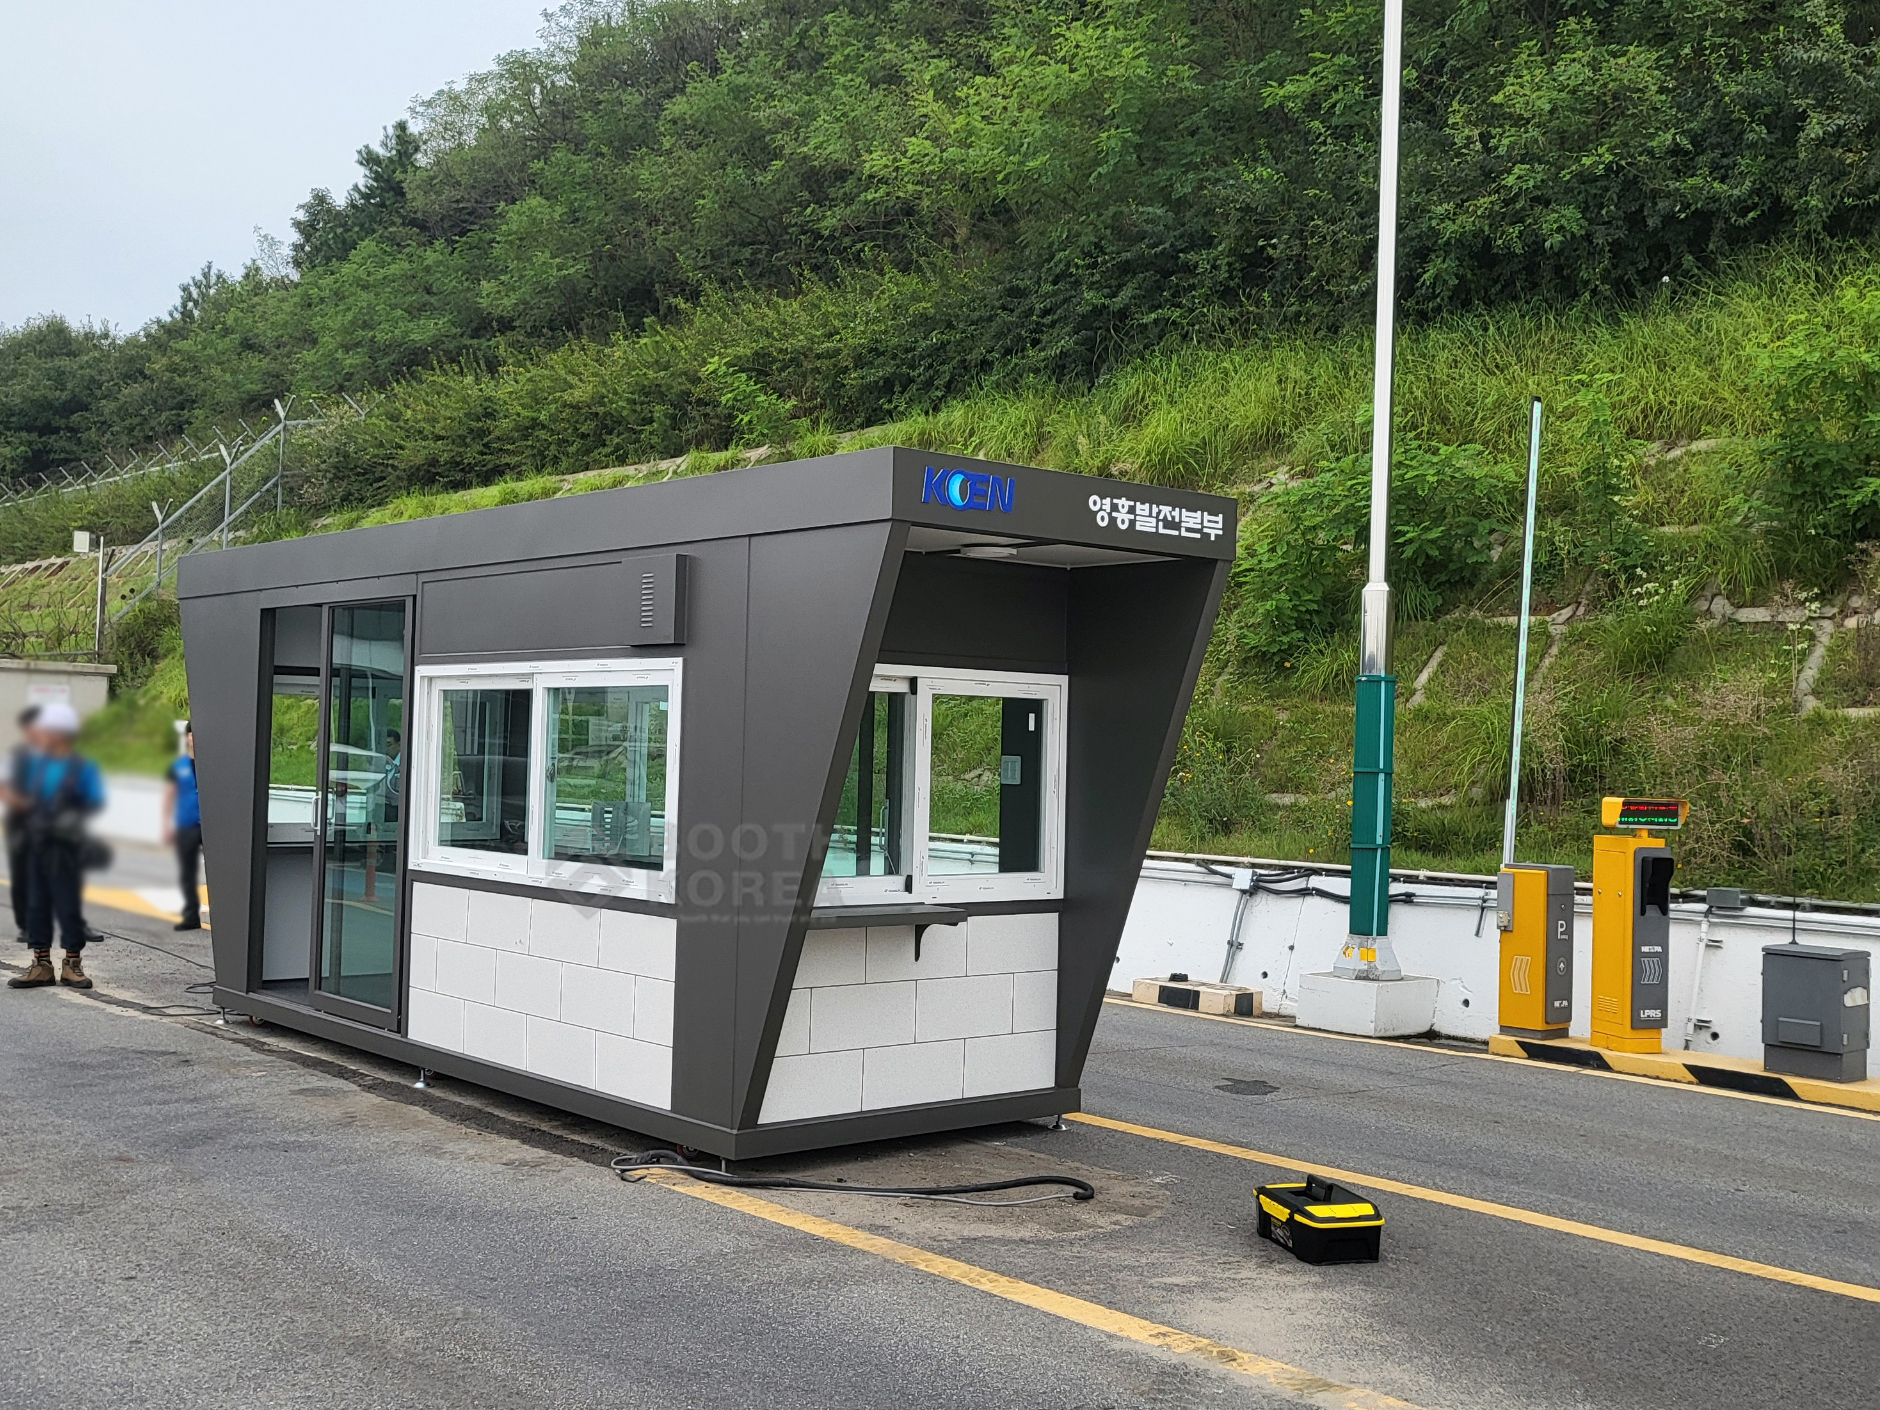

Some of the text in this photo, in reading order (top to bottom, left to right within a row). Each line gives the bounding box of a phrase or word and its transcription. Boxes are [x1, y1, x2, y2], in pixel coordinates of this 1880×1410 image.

[921, 465, 1016, 514] KOEN
[1088, 494, 1224, 541] 영흥발전본부
[1640, 1009, 1662, 1018] LPRS
